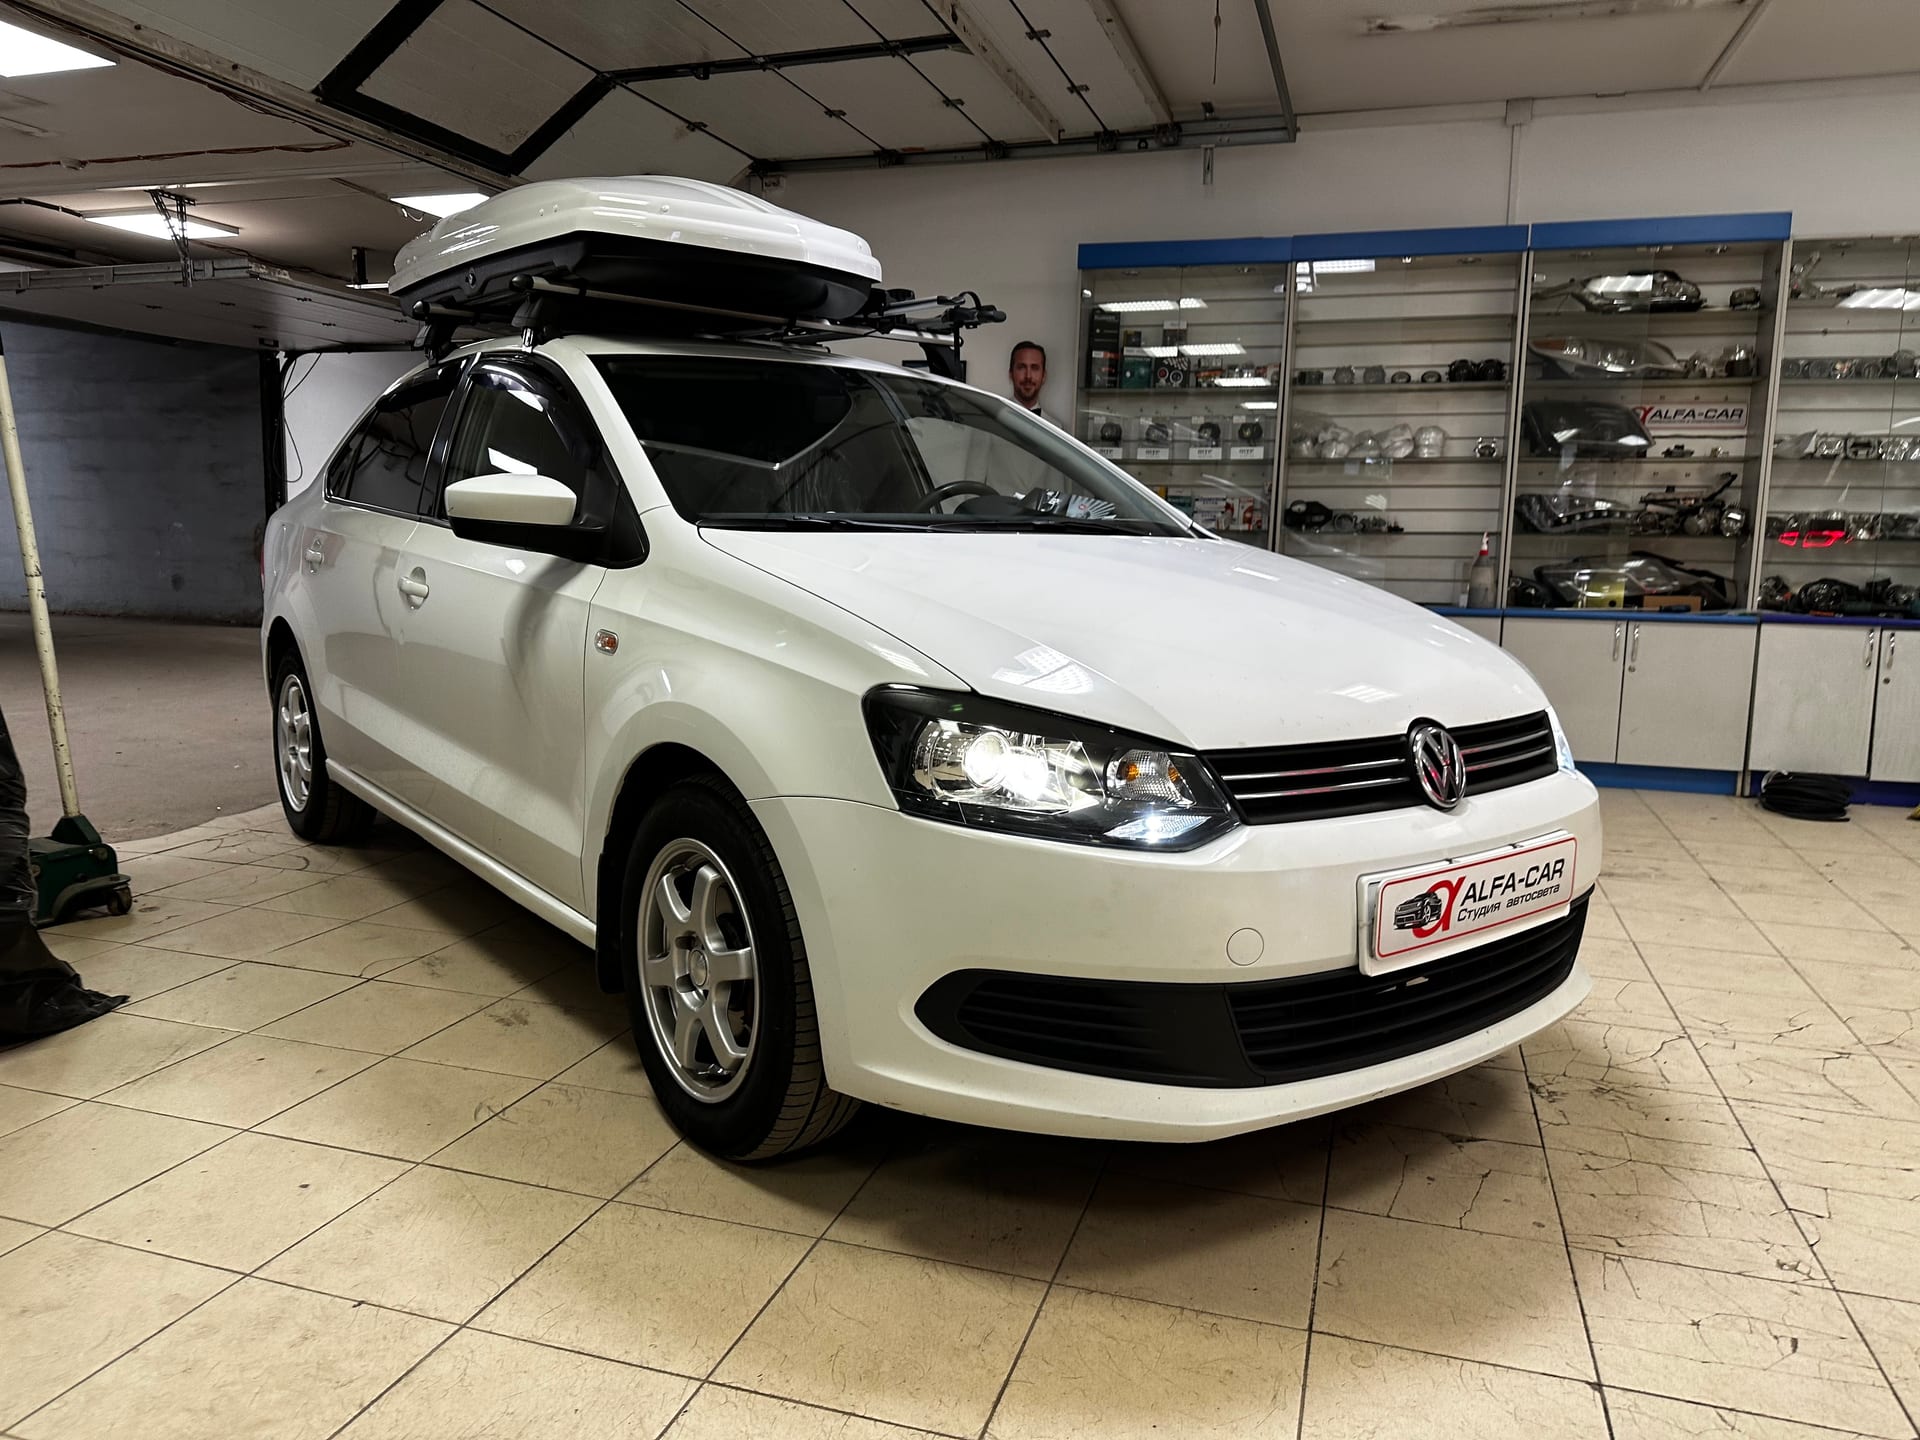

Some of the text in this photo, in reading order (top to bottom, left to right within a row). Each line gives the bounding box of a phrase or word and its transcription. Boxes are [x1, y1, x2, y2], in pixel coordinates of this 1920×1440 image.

[1650, 408, 1744, 420] ALFA-CAR
[1460, 858, 1565, 907] ALFA-CAR
[1457, 884, 1560, 922] Студия автосвета
